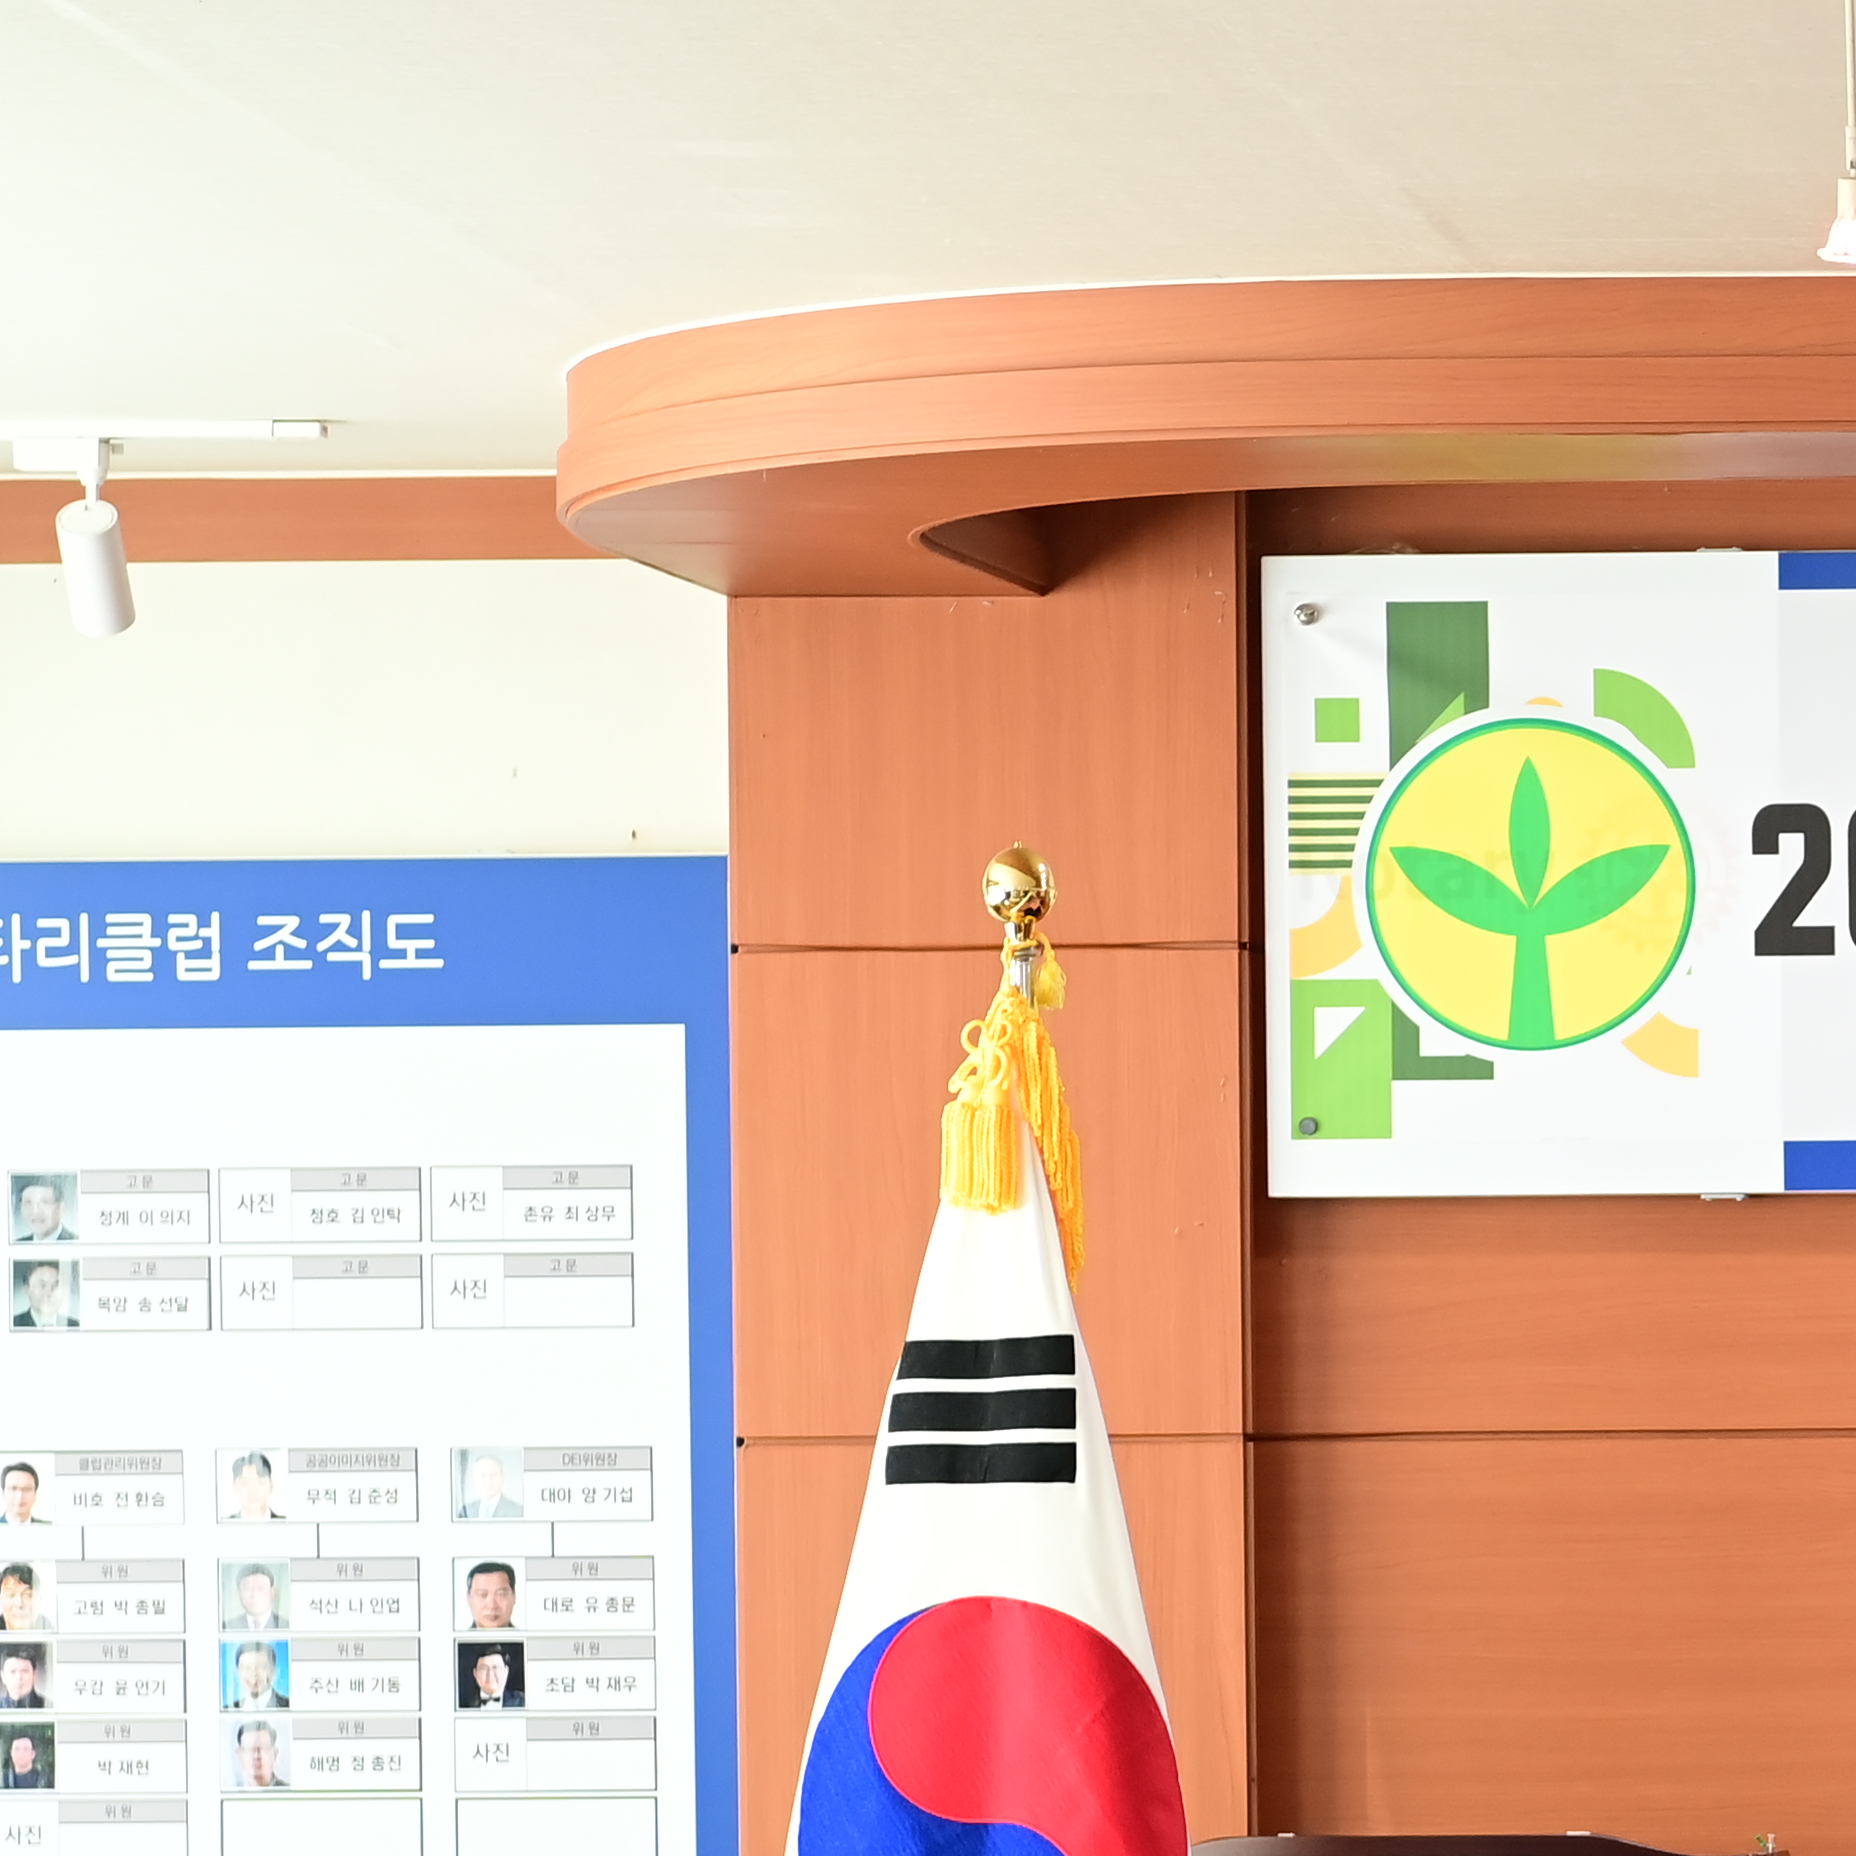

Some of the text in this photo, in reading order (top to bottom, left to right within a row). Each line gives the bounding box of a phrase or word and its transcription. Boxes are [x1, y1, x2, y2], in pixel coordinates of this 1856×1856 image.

[248, 910, 445, 980] 조직도
[237, 1193, 274, 1215] 사진
[448, 1191, 486, 1213] 사진
[138, 1209, 154, 1227] 이
[351, 1207, 365, 1225] 김
[565, 1205, 579, 1222] 최
[238, 1280, 276, 1302] 사진
[450, 1278, 487, 1301] 사진
[305, 1452, 401, 1469] 공공이미지위원장
[562, 1451, 618, 1467] DEI위원장
[348, 1488, 362, 1505] 김
[584, 1596, 599, 1614] 유
[349, 1677, 365, 1694] 배
[585, 1676, 600, 1693] 박
[472, 1742, 510, 1764] 사진
[5, 1825, 42, 1846] 사진
